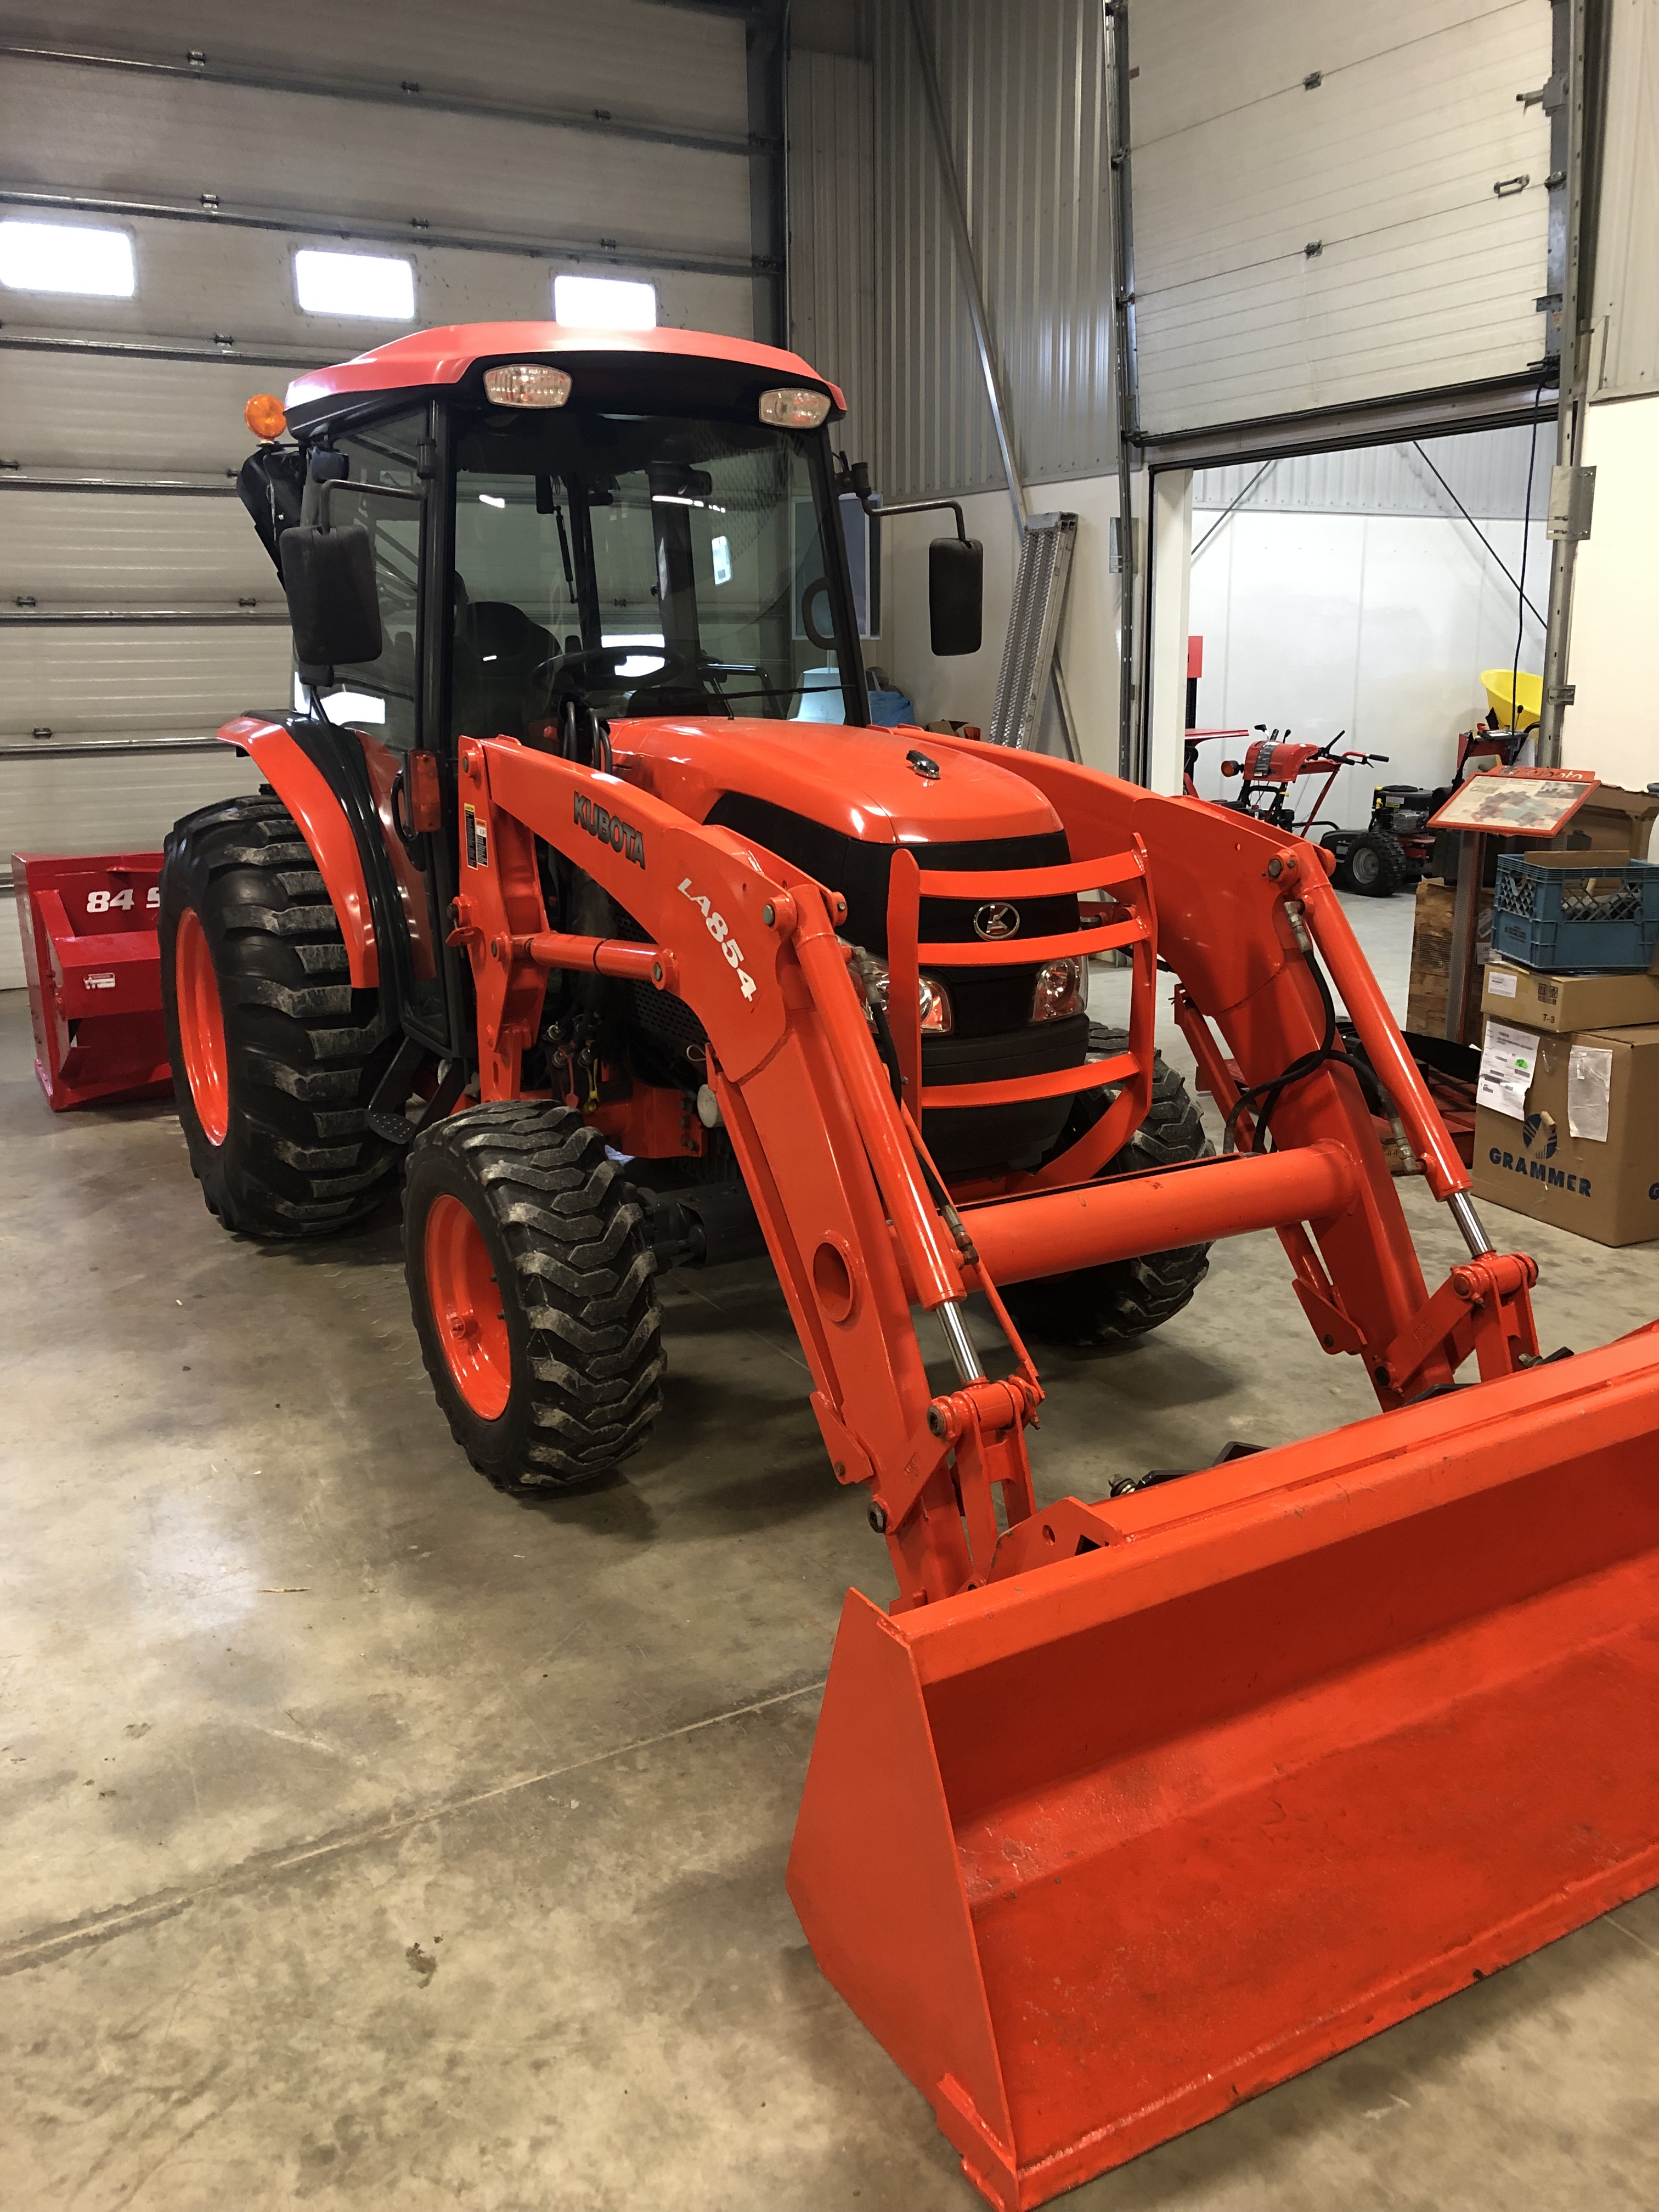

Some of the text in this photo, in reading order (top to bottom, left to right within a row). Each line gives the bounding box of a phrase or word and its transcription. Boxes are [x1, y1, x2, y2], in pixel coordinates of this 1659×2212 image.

[574, 791, 646, 871] KUBOTA
[87, 889, 135, 913] 84
[677, 878, 757, 1002] LA854
[1489, 1147, 1592, 1198] GRAMMER
